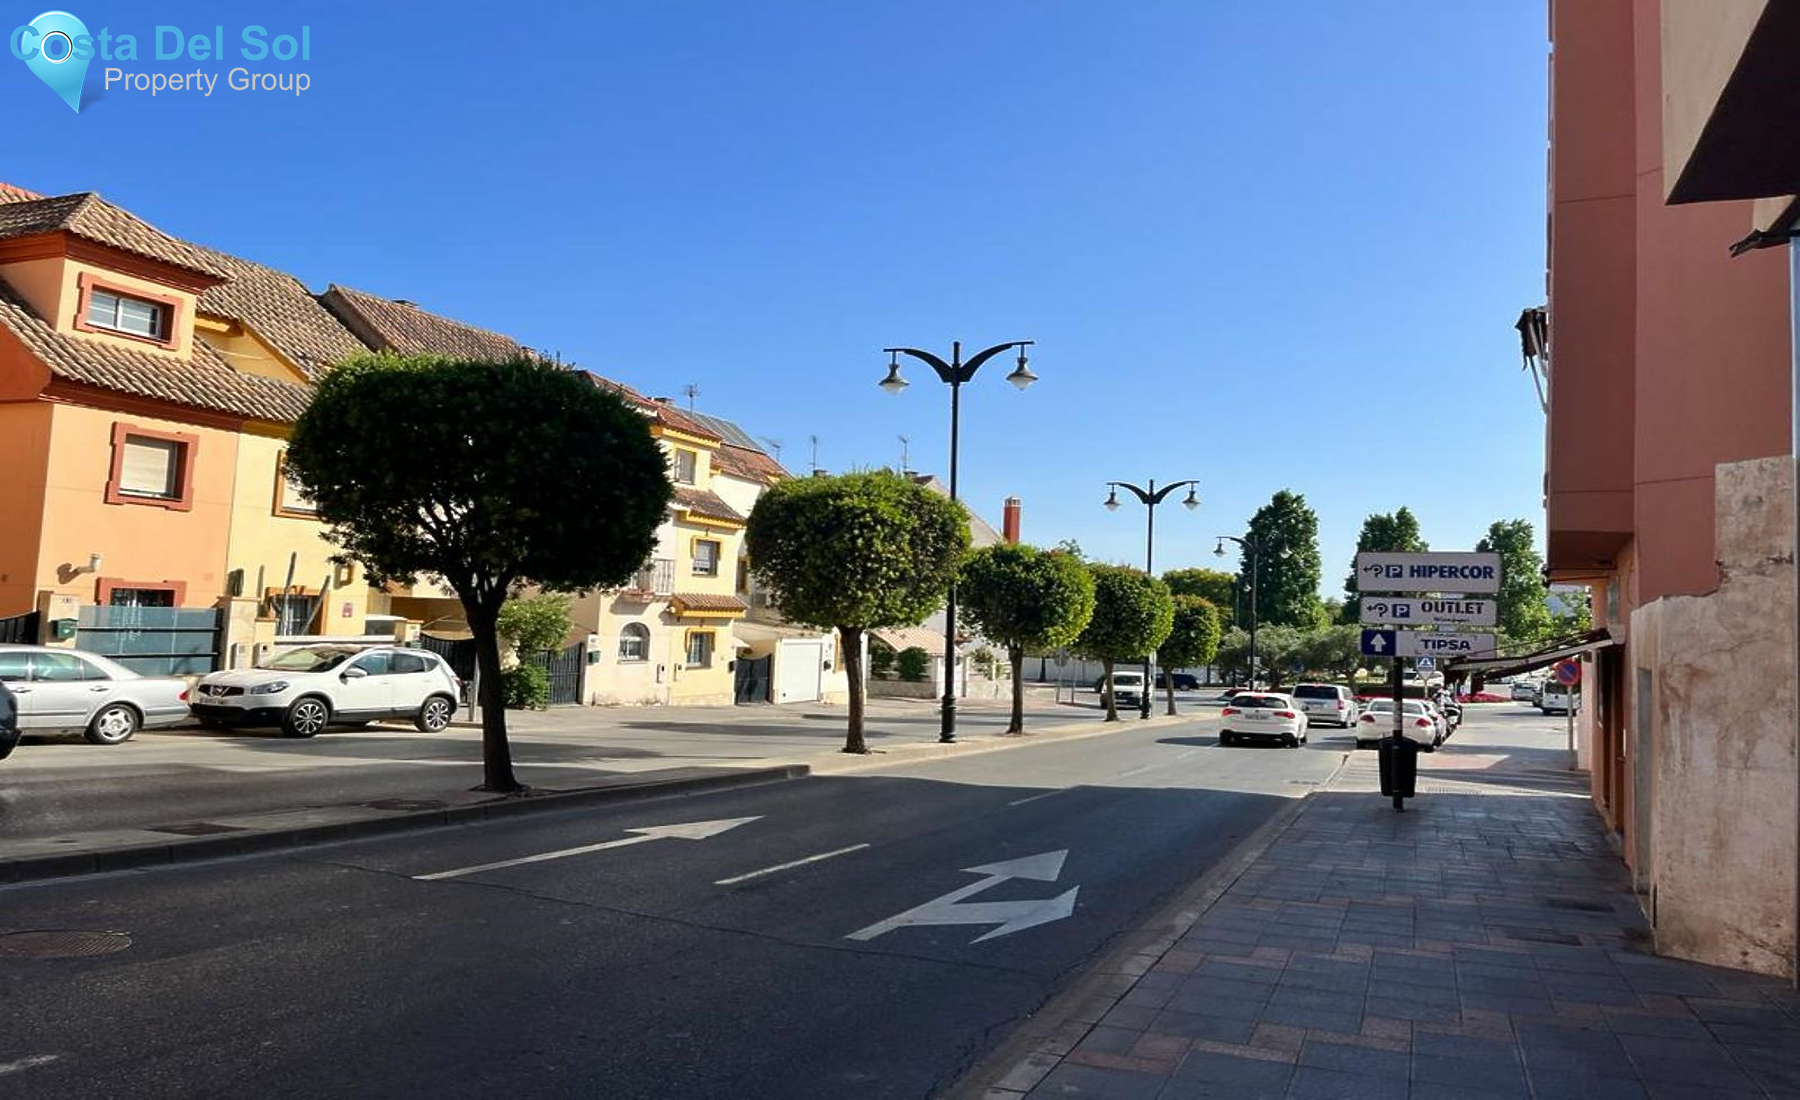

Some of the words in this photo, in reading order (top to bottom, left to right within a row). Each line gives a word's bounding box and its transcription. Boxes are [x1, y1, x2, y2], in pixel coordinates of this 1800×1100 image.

[1410, 565, 1495, 579] HIPERCOR
[1421, 601, 1484, 614] OUTLET
[1421, 639, 1471, 651] TIPSA
